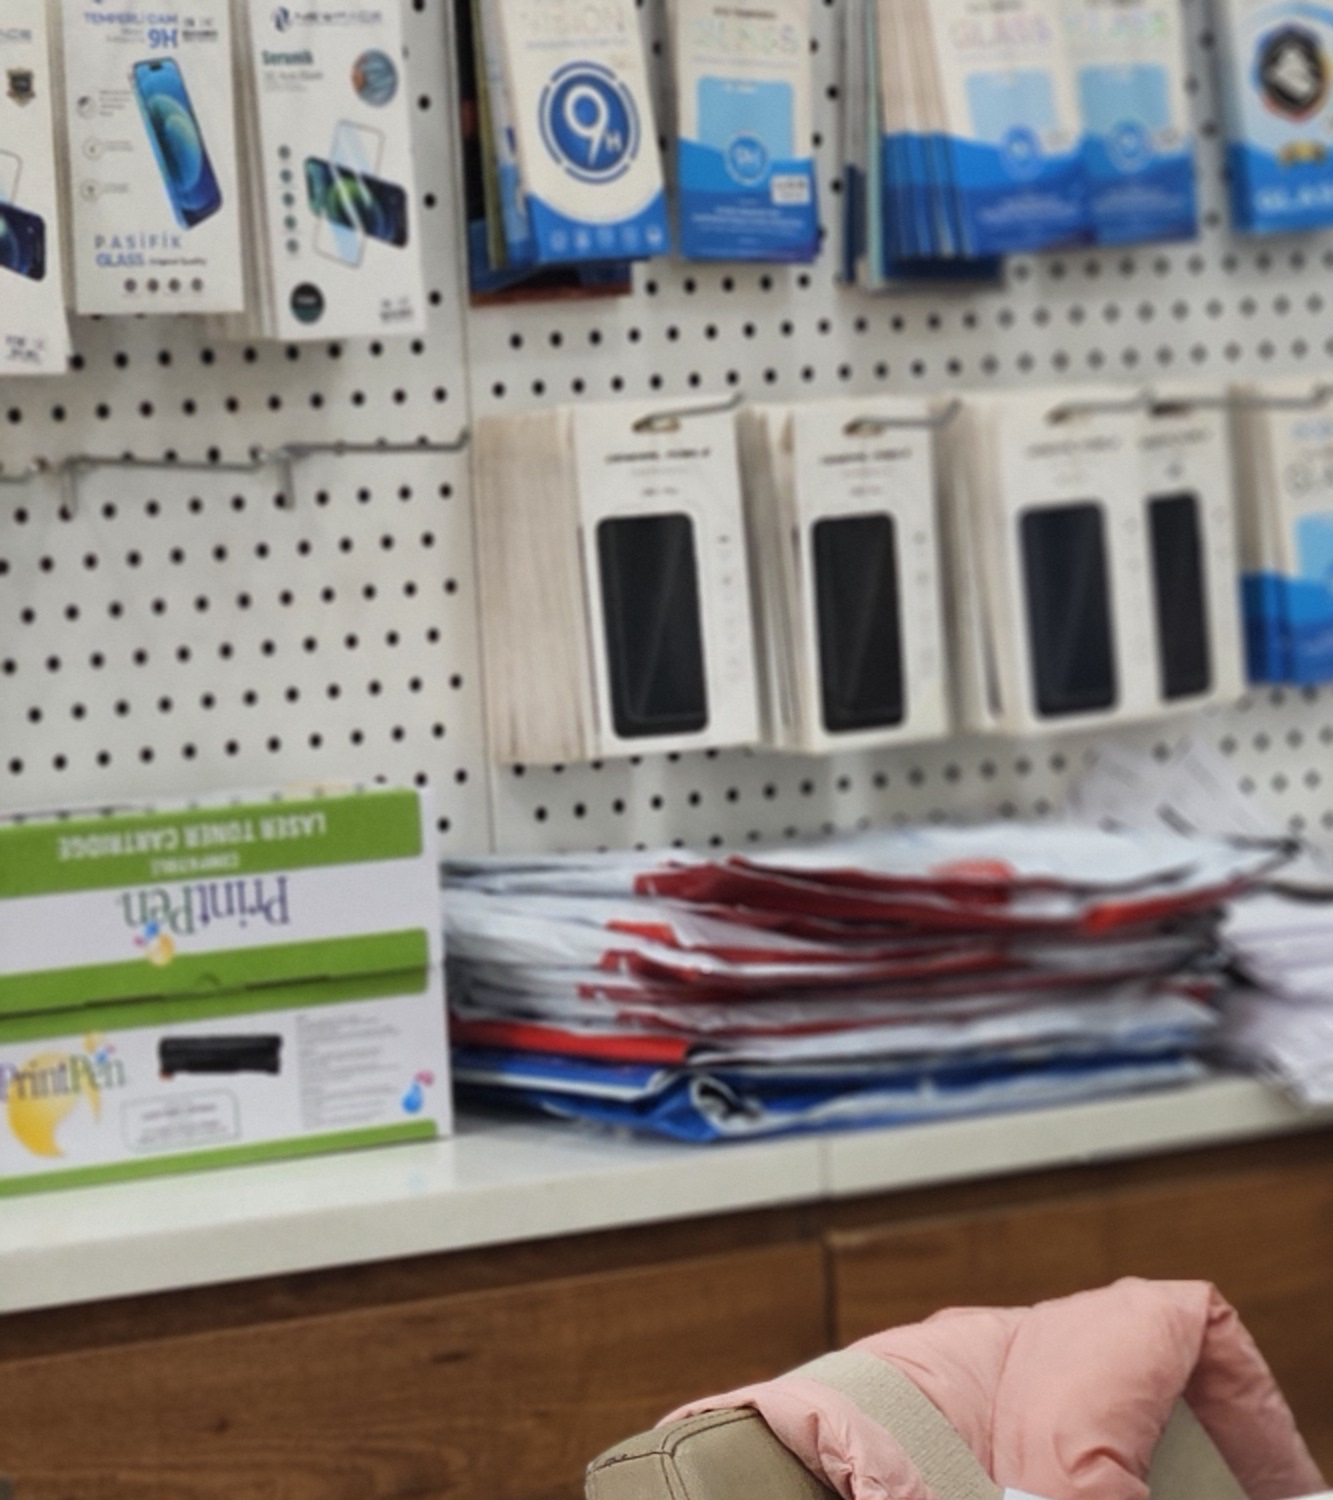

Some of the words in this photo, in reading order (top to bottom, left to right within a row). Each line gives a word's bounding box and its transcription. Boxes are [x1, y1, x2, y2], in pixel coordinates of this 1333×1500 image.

[148, 28, 178, 48] 9H
[260, 812, 327, 840] LASER
[120, 876, 290, 937] PrintPen
